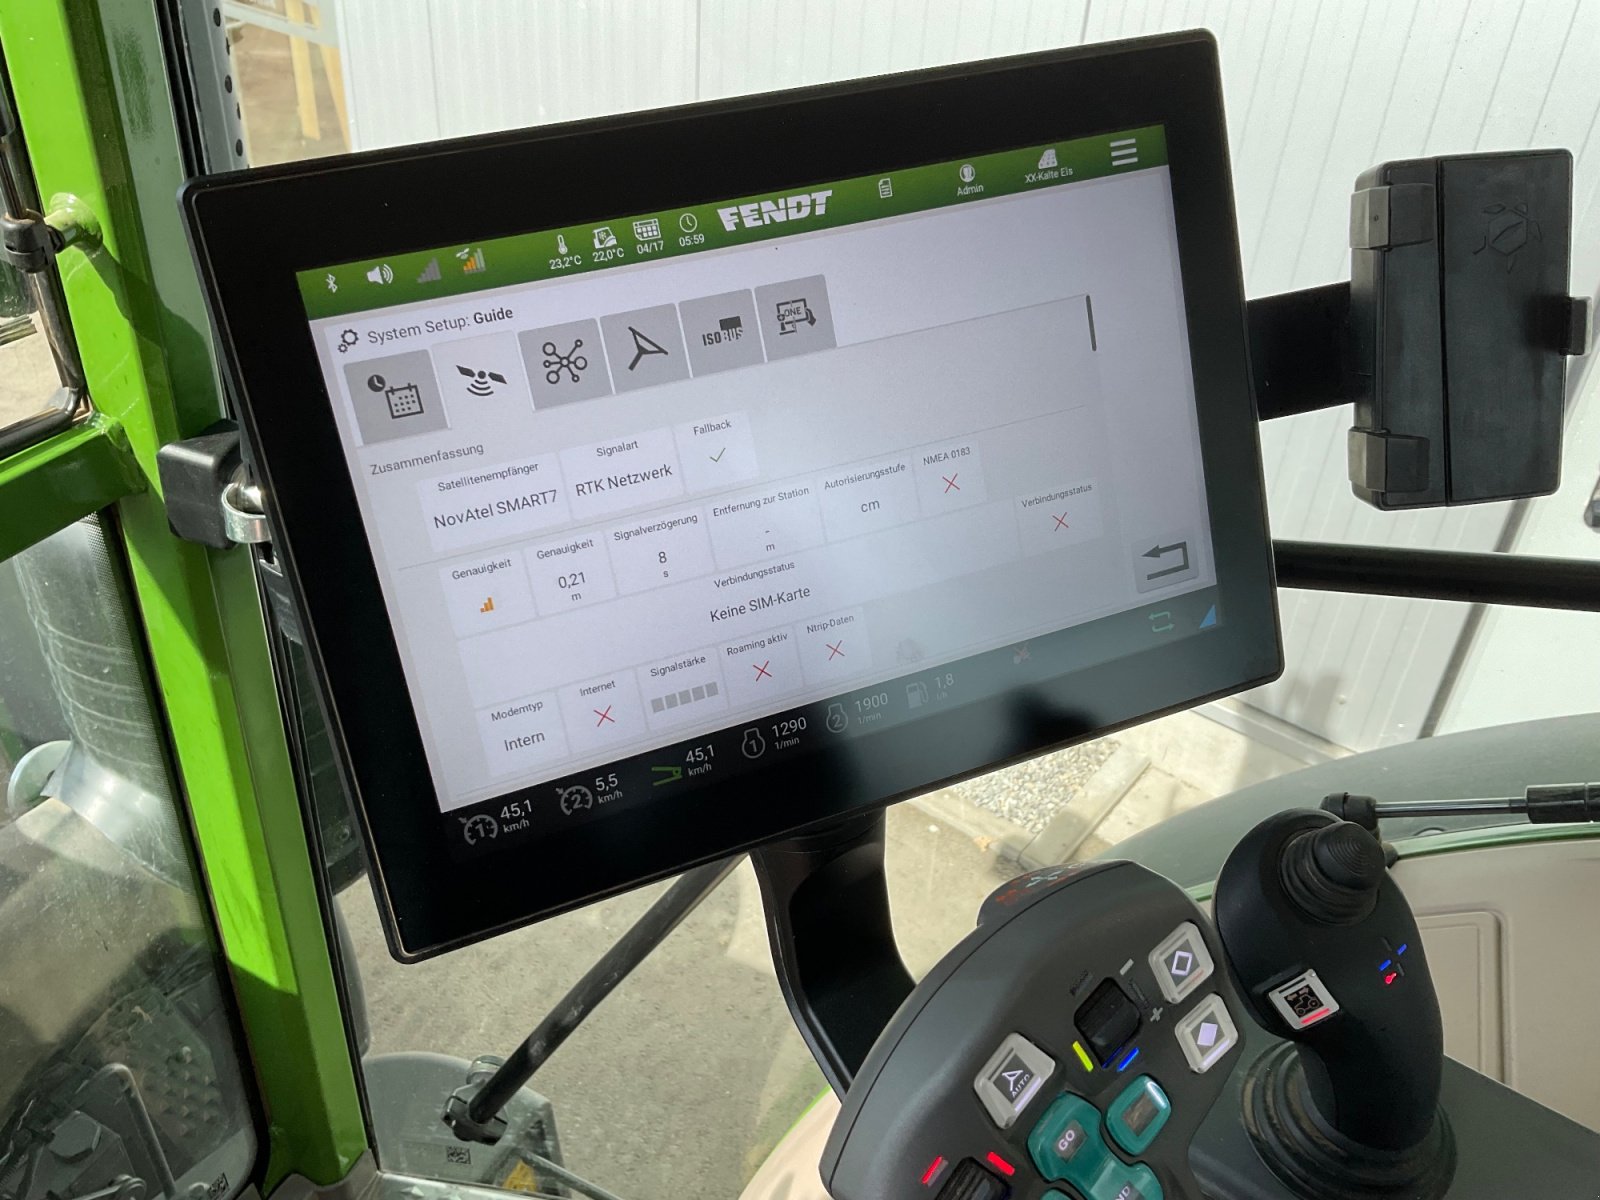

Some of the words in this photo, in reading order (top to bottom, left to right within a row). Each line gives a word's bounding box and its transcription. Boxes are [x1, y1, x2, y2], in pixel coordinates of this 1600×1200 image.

[1061, 167, 1073, 177] Eis
[957, 183, 985, 196] Admin
[717, 190, 832, 232] FENDT
[636, 241, 665, 255] 04/17
[678, 233, 706, 248] 05:59
[549, 254, 582, 270] 23,2°C
[592, 247, 625, 263] 22,0°C
[784, 306, 802, 317] ONE
[368, 324, 422, 344] System
[425, 315, 471, 336] Setup:
[473, 307, 514, 326] Guide
[693, 419, 732, 435] Fallback
[596, 440, 639, 457] Signalart
[922, 453, 950, 466] NMEA
[950, 447, 971, 459] 0183
[370, 443, 485, 476] Zusammenfassung
[437, 462, 539, 492] Satellitenempfänger
[575, 479, 606, 497] RTK
[607, 463, 673, 490] Netzwerk
[824, 463, 906, 489] Autorisierungsstufe
[712, 496, 762, 518] Entfernung
[762, 495, 777, 506] zur
[777, 486, 810, 502] Station
[1021, 483, 1093, 508] Verbindungsstatus
[433, 504, 495, 529] NovAtel
[496, 488, 558, 515] SMART7
[860, 501, 881, 513] cm
[613, 513, 699, 541] Signalverzögerung
[536, 538, 595, 560] Genauigkeit
[765, 543, 775, 551] m
[658, 551, 668, 564] 8
[452, 558, 512, 580] Genauigkeit
[714, 561, 796, 588] Verbindungsstatus
[558, 571, 587, 589] 0,21
[571, 593, 582, 601] m
[710, 602, 747, 622] Keine
[749, 586, 812, 612] SIM-Karte
[806, 614, 855, 634] Ntrip-Daten
[726, 639, 766, 657] Roaming
[766, 633, 789, 648] aktiv
[650, 655, 707, 678] Signalstärke
[579, 680, 616, 697] Internet
[935, 672, 955, 690] 1,8
[491, 700, 544, 722] Modemtyp
[855, 692, 889, 713] 1900
[771, 716, 808, 738] 1290
[857, 712, 882, 726] 1/min
[504, 731, 546, 751] Intern
[774, 736, 801, 752] 1/min
[685, 744, 716, 767] 45,1
[687, 763, 713, 778] km/h
[595, 773, 619, 793] 5,5
[598, 790, 624, 806] km/h
[499, 799, 533, 822] 45,1
[503, 819, 531, 834] km/h
[1011, 1074, 1030, 1098] AUTO
[1058, 1130, 1075, 1151] GO
